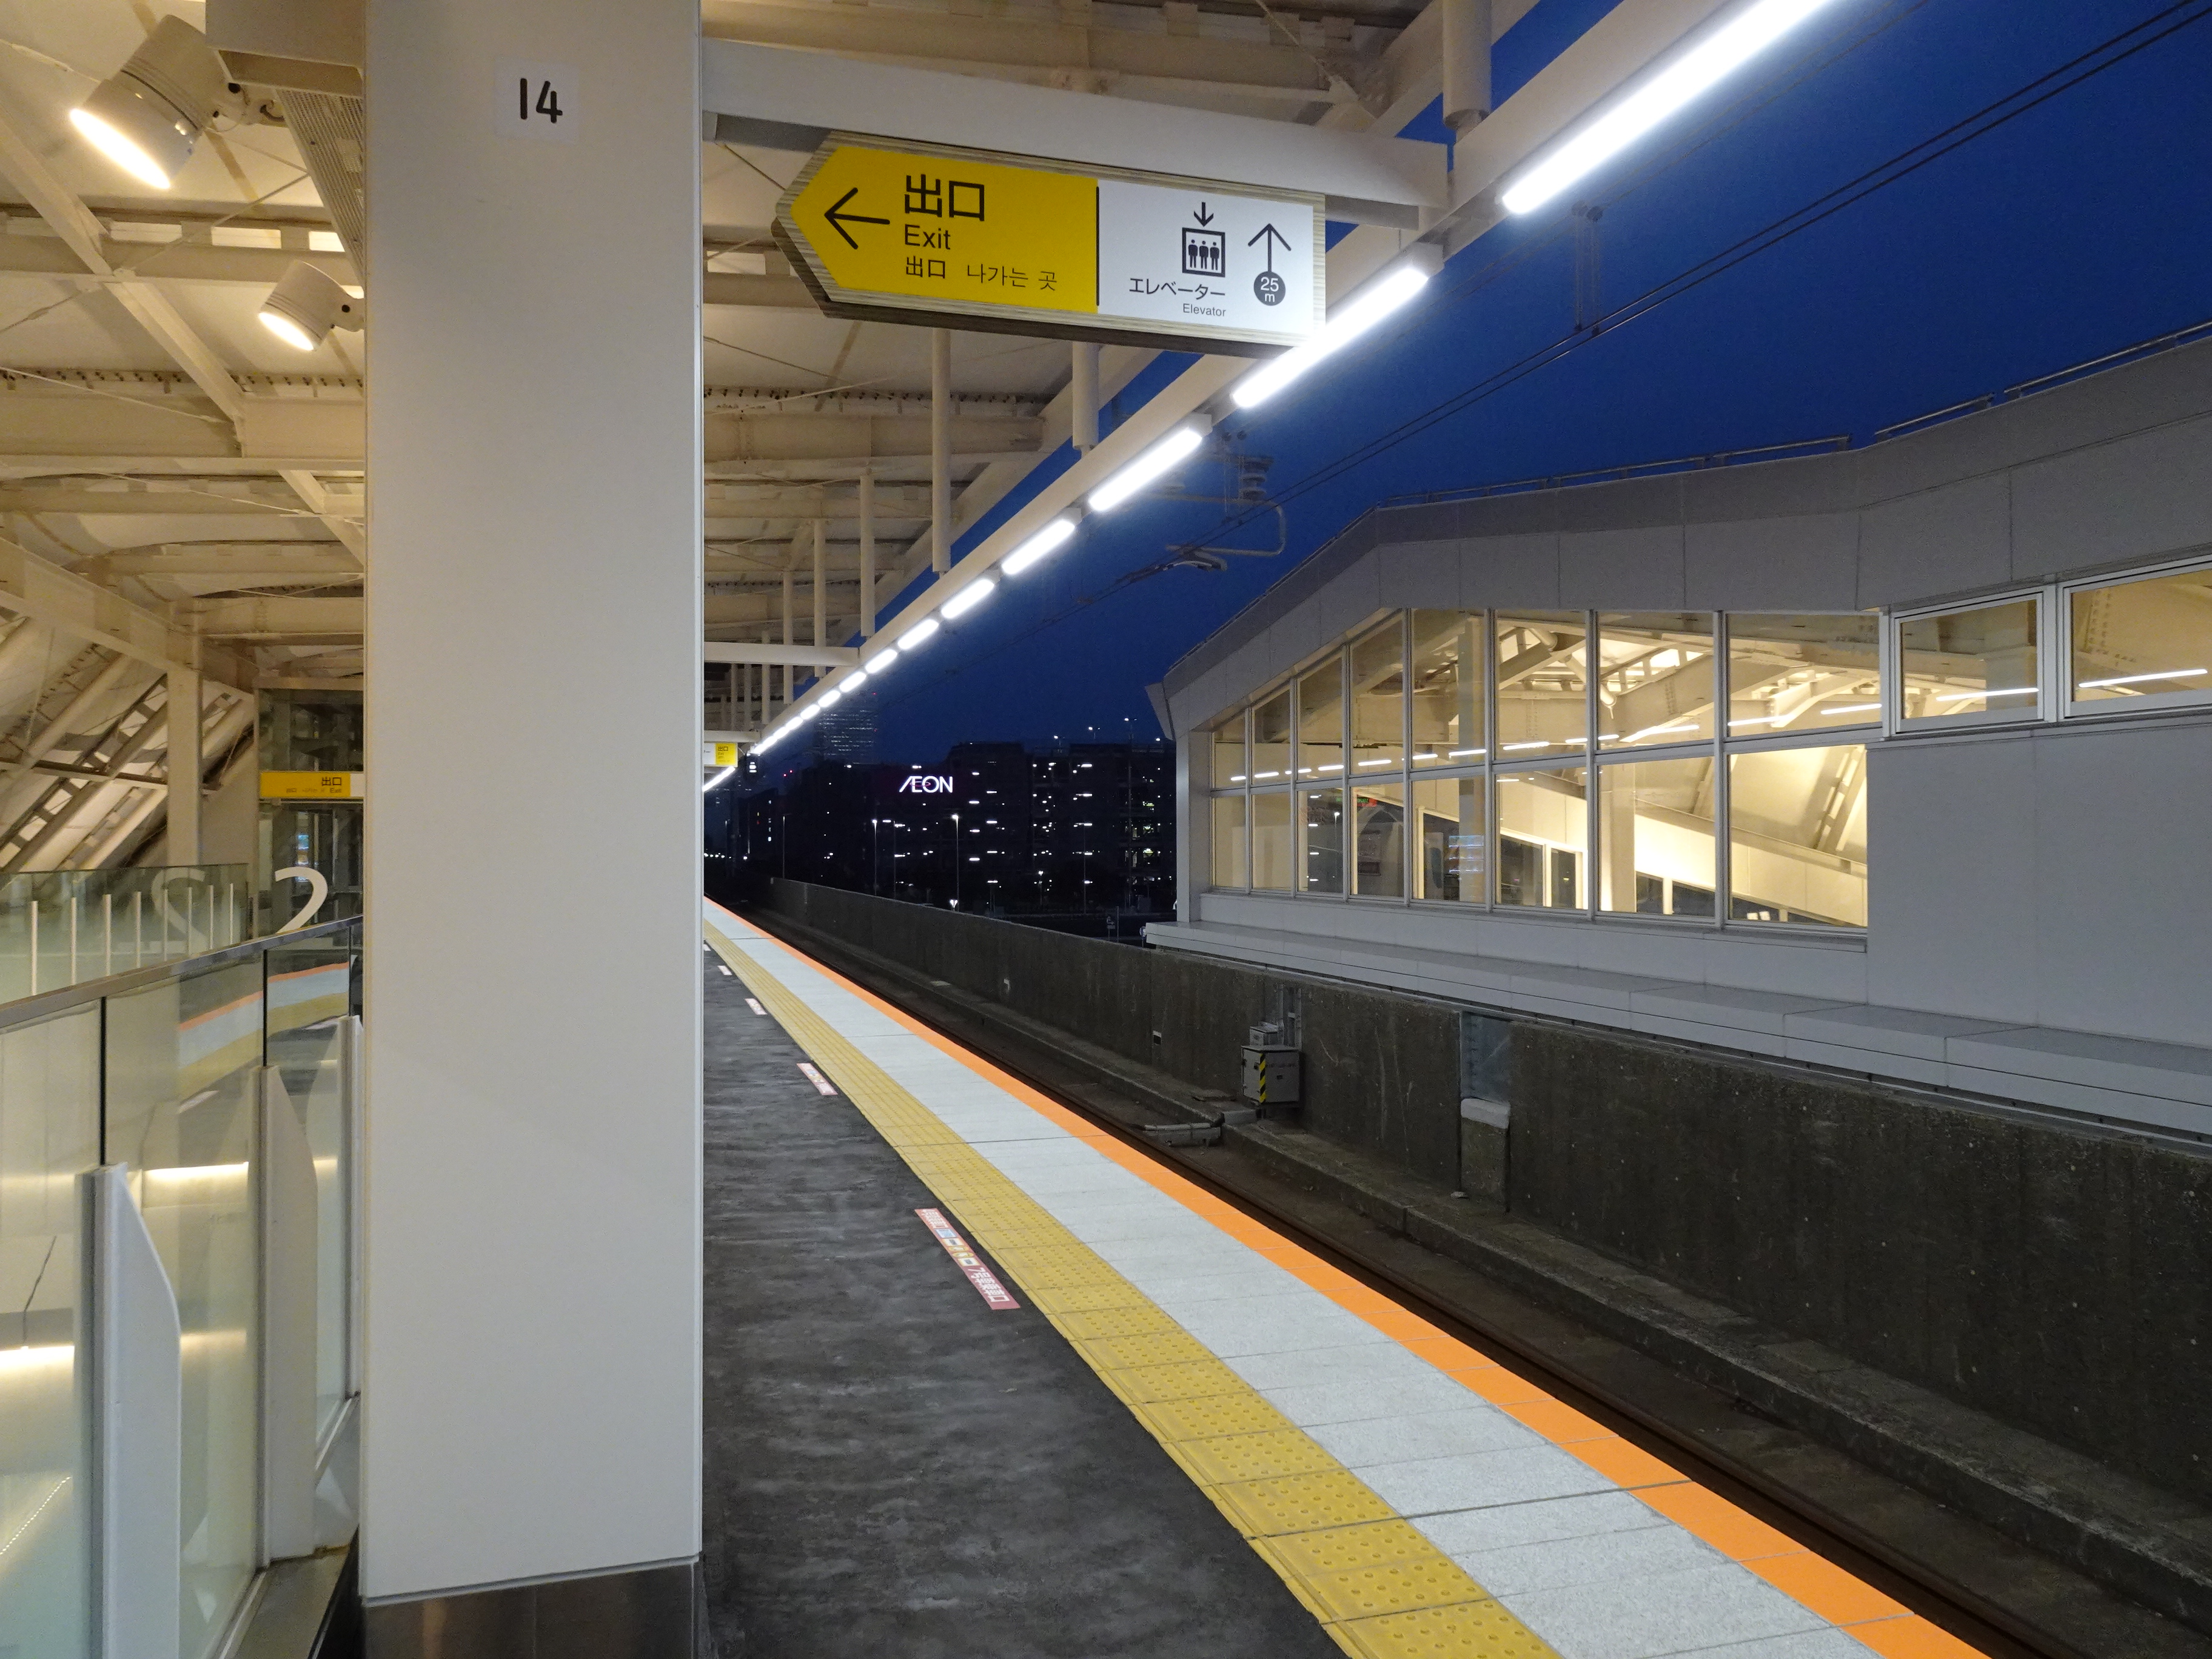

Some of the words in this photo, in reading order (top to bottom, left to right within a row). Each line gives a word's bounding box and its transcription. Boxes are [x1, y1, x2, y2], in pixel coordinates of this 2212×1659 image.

[520, 78, 563, 124] 14
[904, 173, 985, 222] 出口
[904, 224, 951, 250] Exit
[905, 255, 945, 279] 出口
[967, 263, 1028, 288] 나가는
[1037, 270, 1057, 291] 곳
[1129, 278, 1225, 300] エレベーター
[1260, 276, 1279, 292] 25
[1182, 303, 1227, 317] Elevator
[1264, 293, 1276, 303] m
[321, 776, 342, 786] 出口
[275, 866, 329, 934] 2
